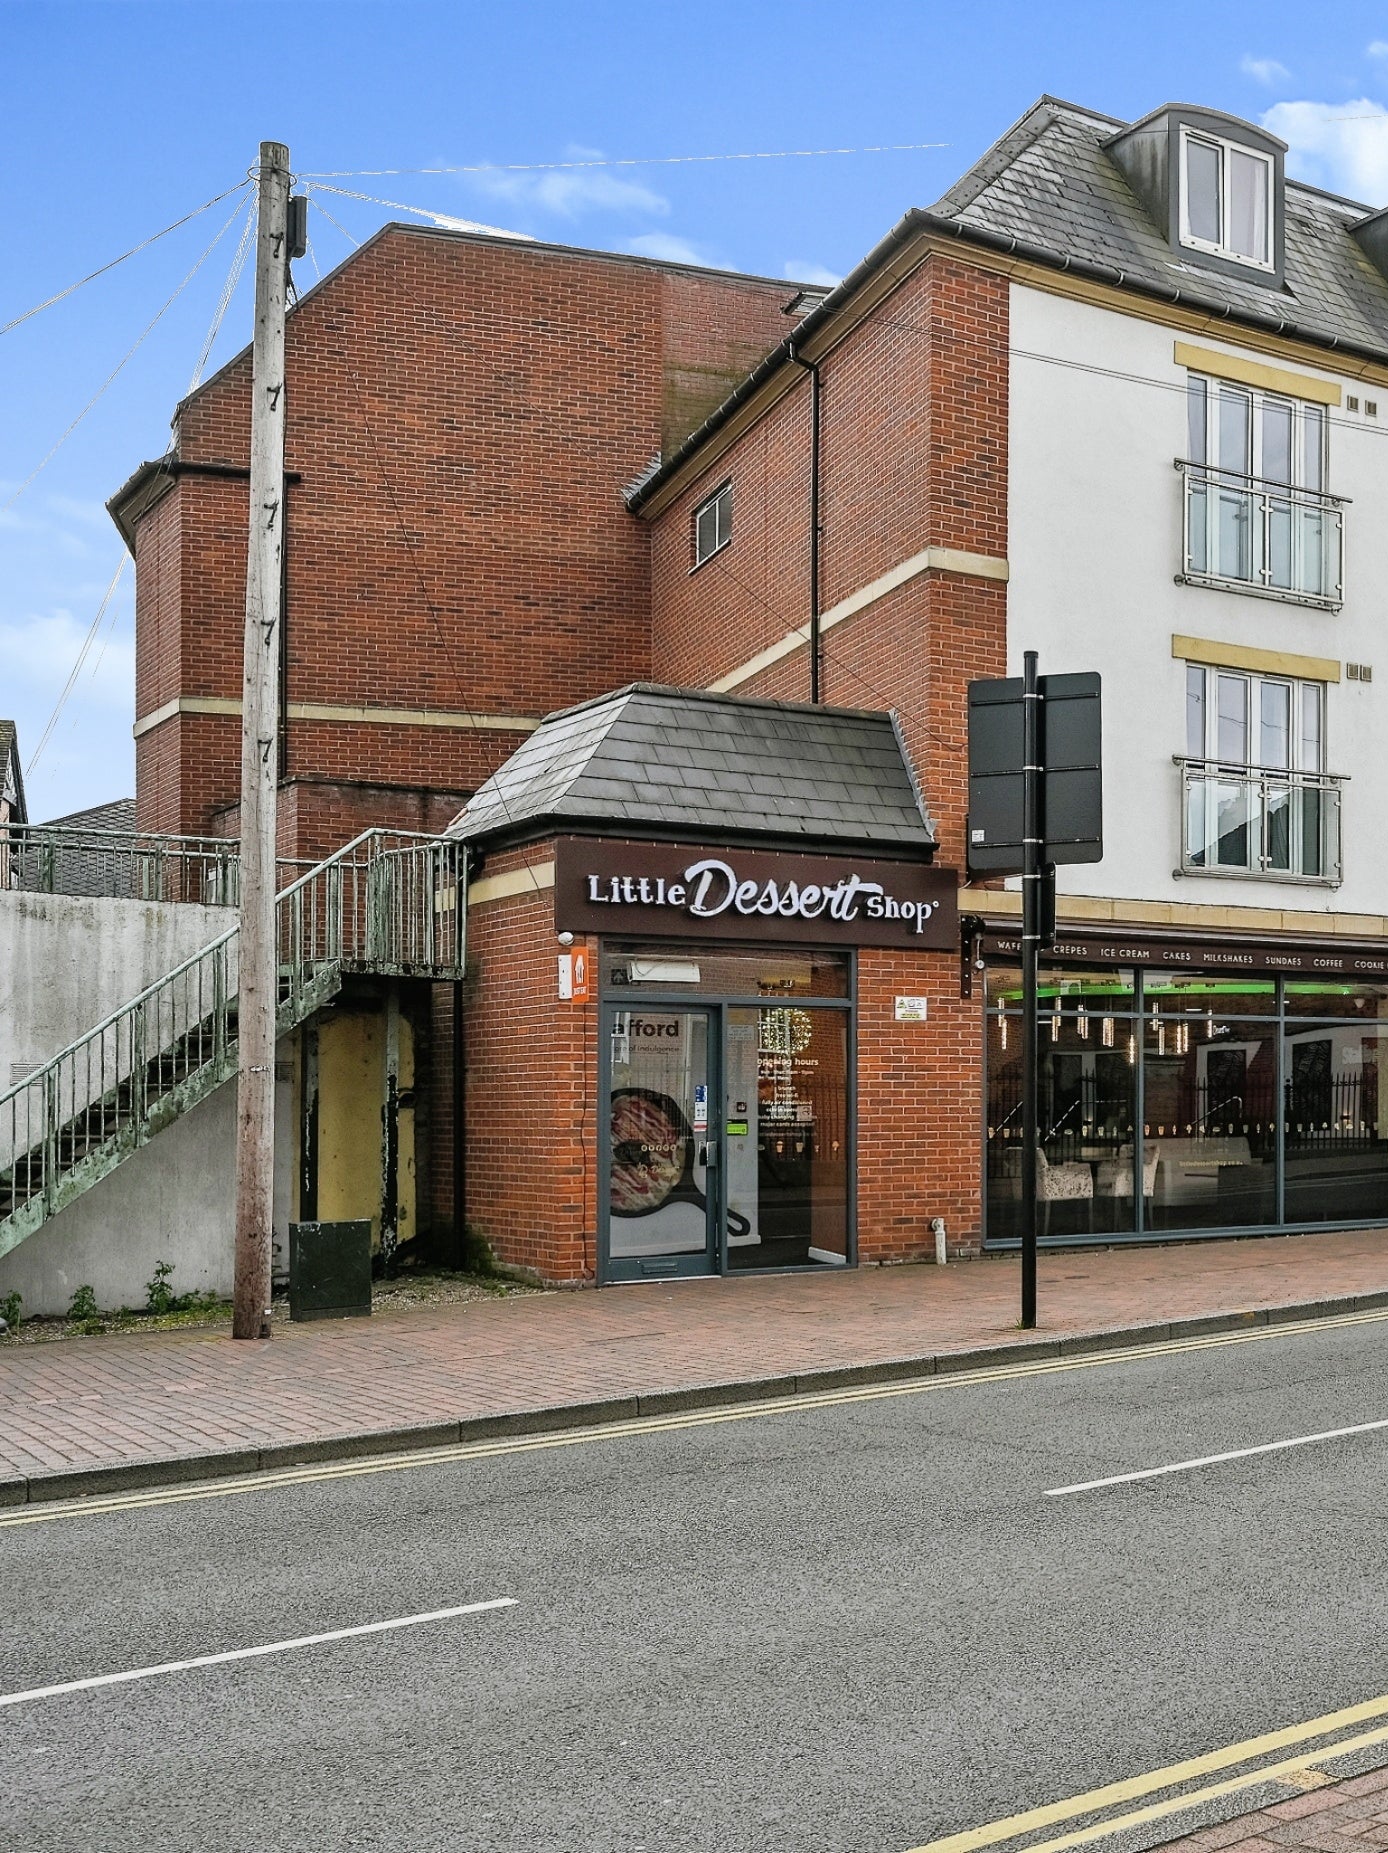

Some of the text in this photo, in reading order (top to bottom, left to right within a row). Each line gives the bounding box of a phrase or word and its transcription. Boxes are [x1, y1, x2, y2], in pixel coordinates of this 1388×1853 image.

[588, 874, 686, 905] Little
[684, 859, 884, 922] Dessert
[1053, 945, 1088, 956] CREPES
[1101, 948, 1116, 957] ICE
[1119, 949, 1150, 959] CREAM
[1163, 951, 1192, 961] CAKES
[1203, 953, 1253, 964] MILKSHAKES
[1265, 956, 1302, 966] SUNDAES
[1313, 958, 1343, 968] COFFEE
[1354, 960, 1384, 970] COOKIE
[794, 1057, 819, 1066] hours
